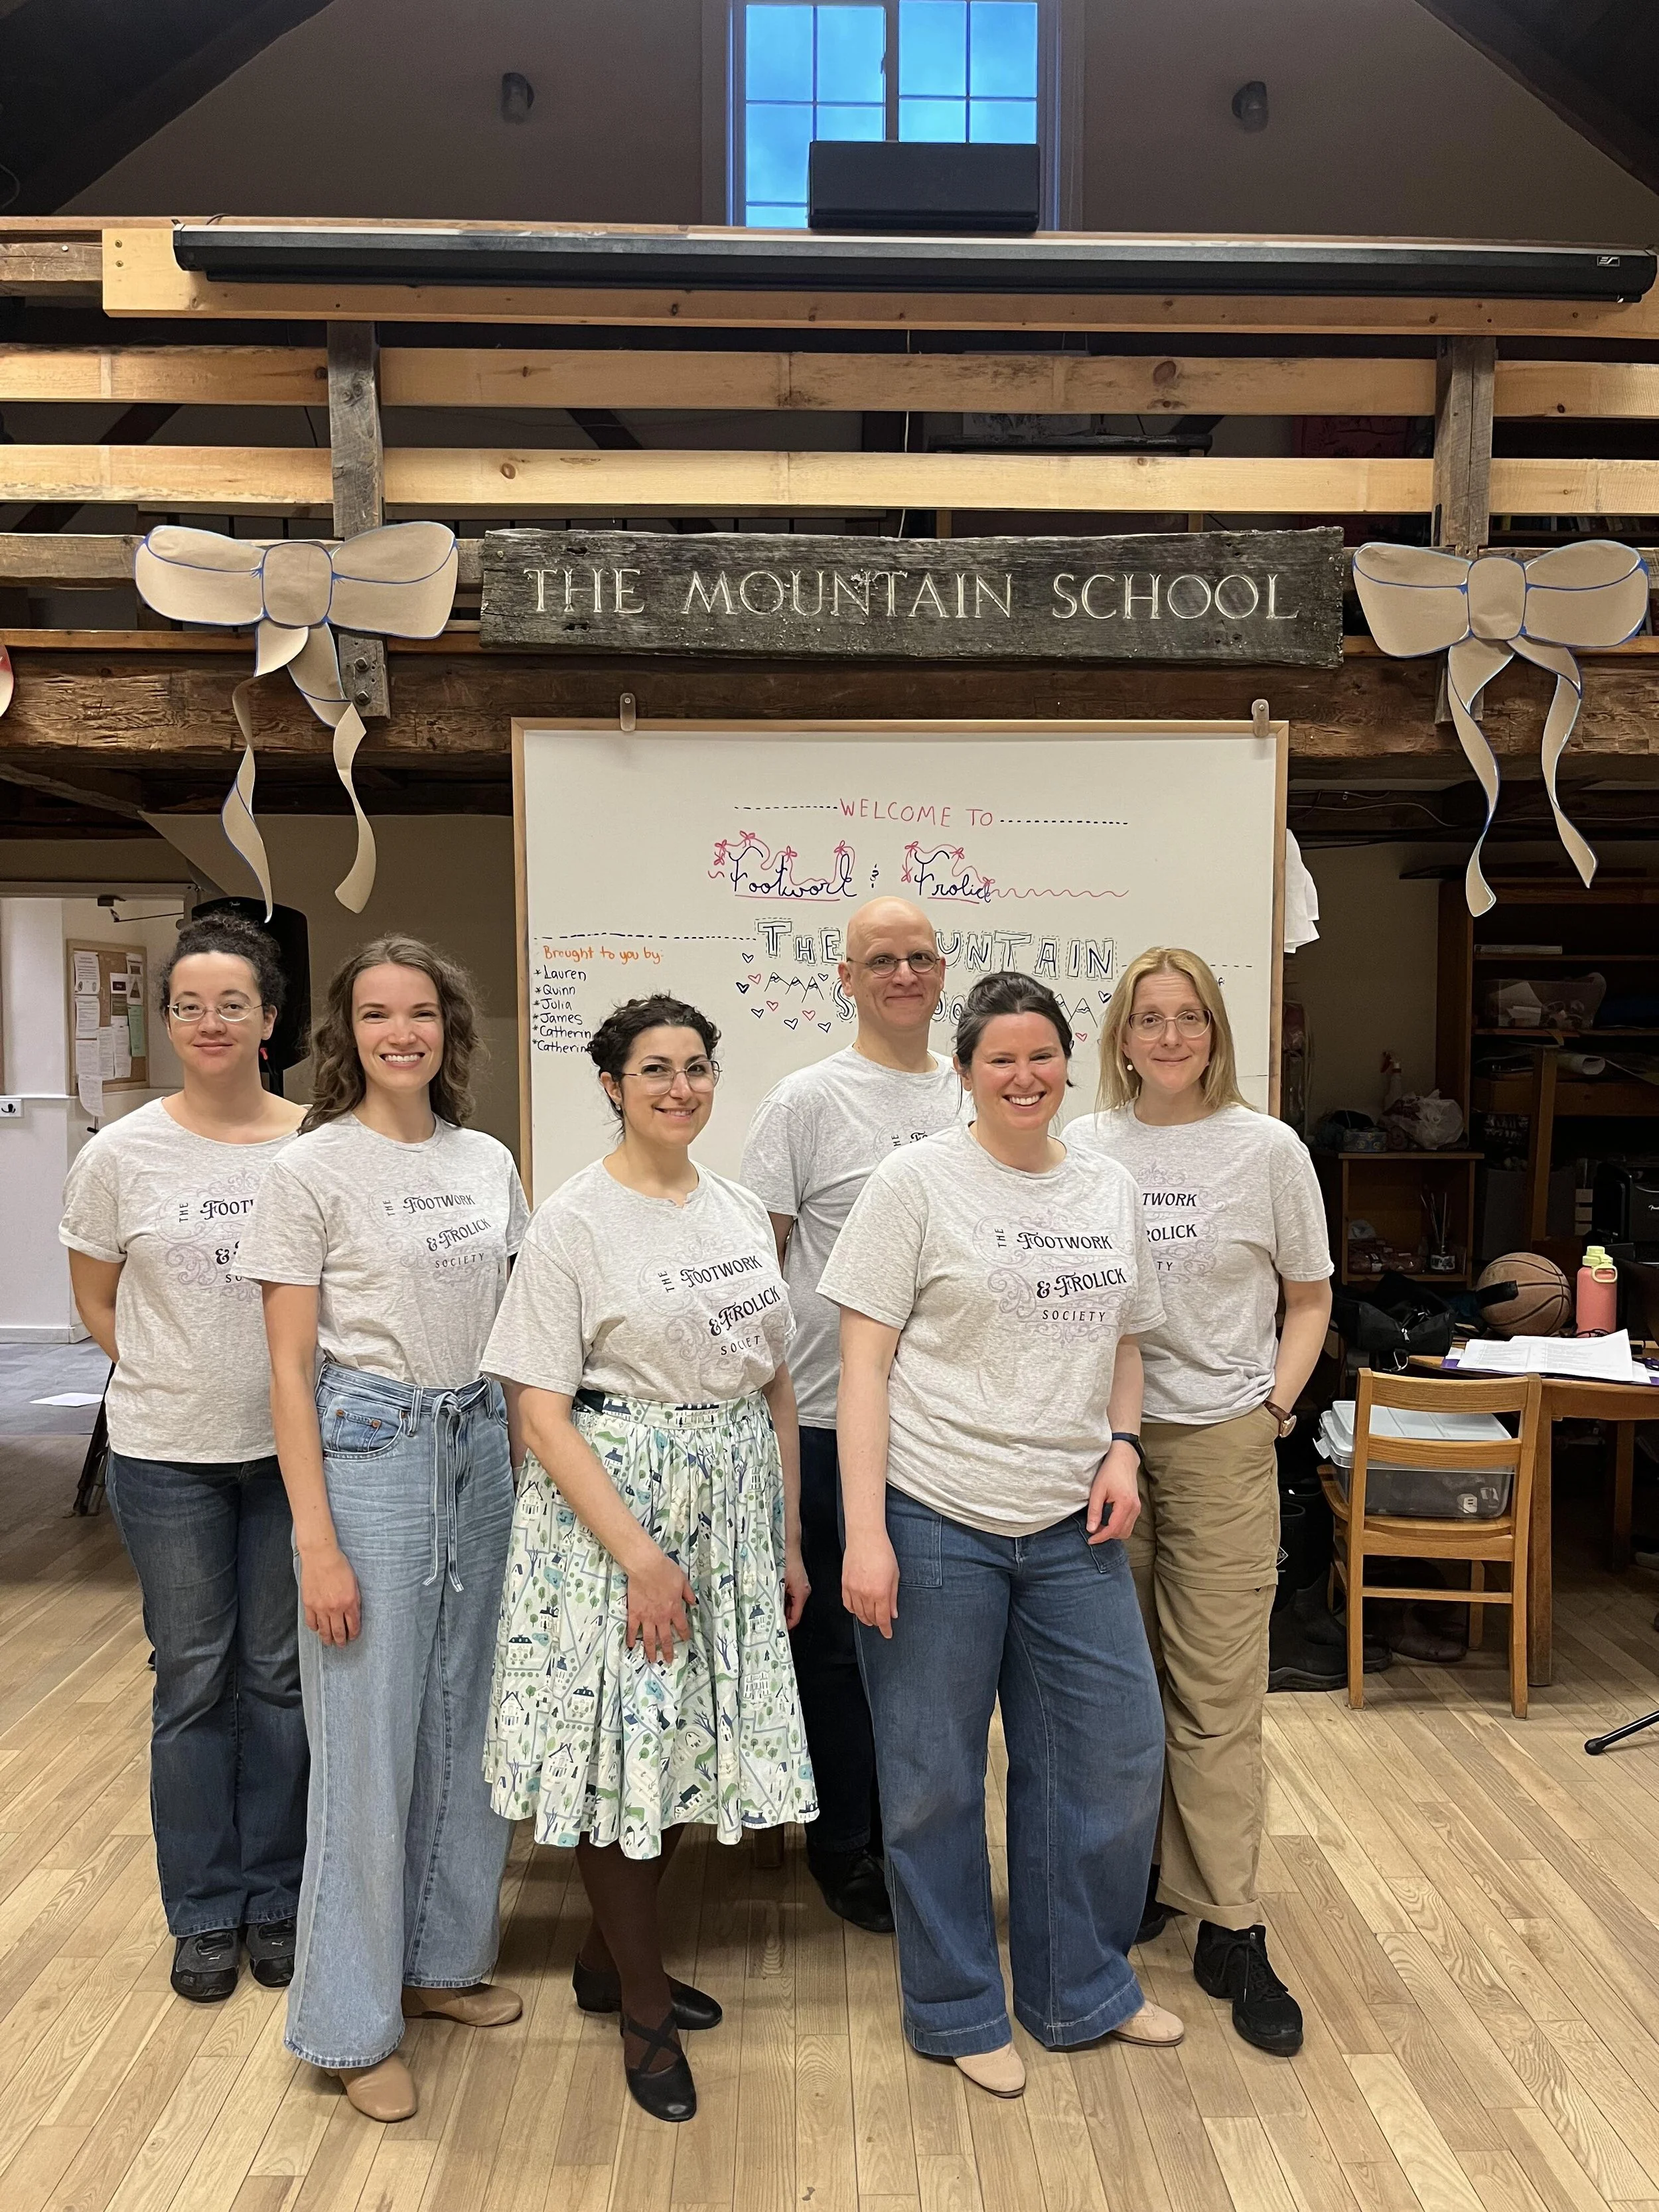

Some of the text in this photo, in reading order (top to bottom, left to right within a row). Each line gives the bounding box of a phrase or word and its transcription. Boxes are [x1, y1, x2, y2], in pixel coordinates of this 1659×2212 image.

[523, 567, 1299, 620] THE MOUNTAIN SCHOOL
[840, 798, 993, 828] WELCOME TO
[543, 946, 593, 962] Brought
[600, 946, 614, 960] to
[620, 951, 639, 965] you
[757, 920, 1115, 980] THE UNTAIN
[543, 964, 587, 982] Lauren
[543, 984, 575, 995] Quinn
[541, 998, 572, 1011] Julia
[540, 1013, 583, 1025] James
[540, 1025, 591, 1039] Catherin
[538, 1040, 588, 1053] Catherin
[891, 1134, 902, 1147] HE
[383, 1199, 396, 1217] THE
[1143, 1193, 1198, 1207] TWORK
[179, 1203, 189, 1223] THE
[199, 1199, 255, 1220] FOOT
[426, 1218, 492, 1252] & FROLICK
[995, 1228, 1007, 1248] THE
[1017, 1232, 1114, 1250] FOOTWORK
[1147, 1224, 1198, 1242] OLICK
[215, 1248, 230, 1265] &
[435, 1252, 485, 1269] SOCIETY
[680, 1255, 763, 1288] FOOTWORK
[657, 1270, 676, 1293] THE
[1037, 1268, 1127, 1299] & FROLICK
[709, 1285, 781, 1337] & FROLICK
[1042, 1309, 1106, 1322] SOCIETY
[721, 1335, 761, 1355] SOCIET
